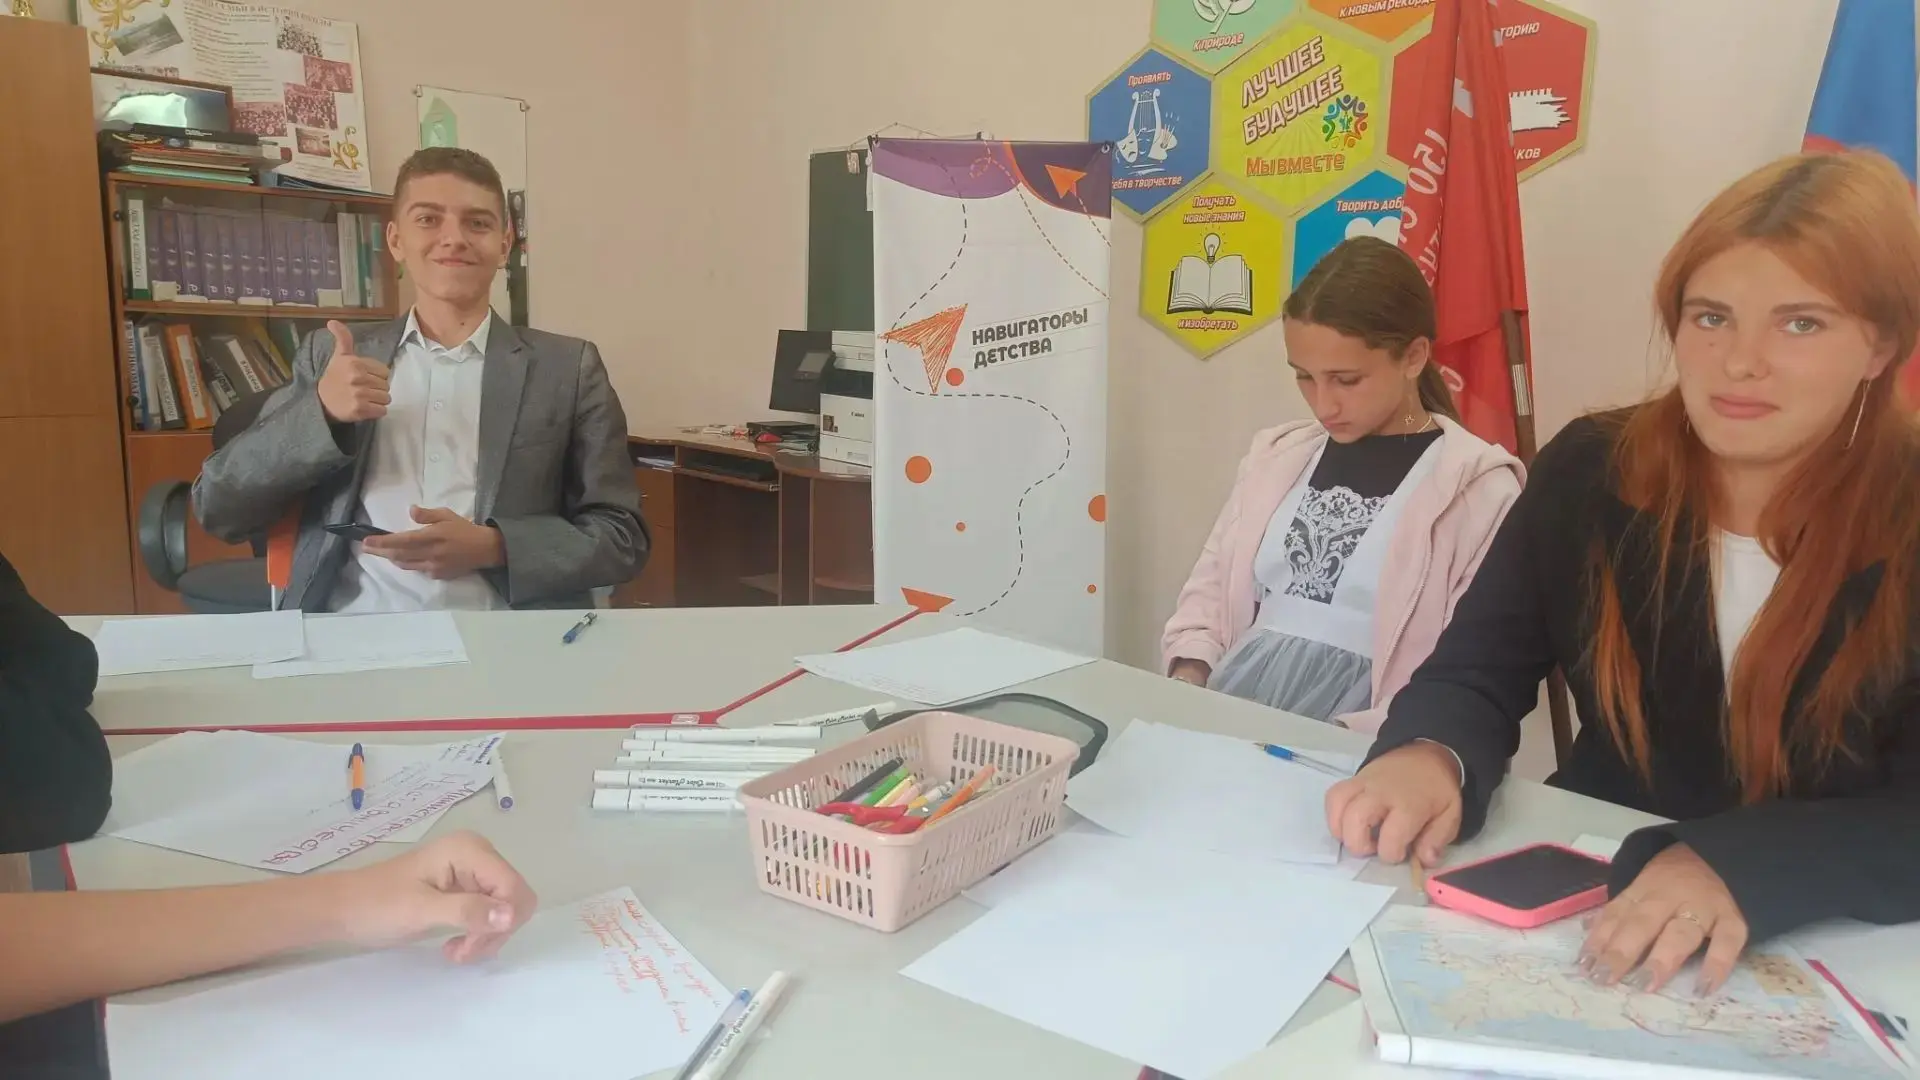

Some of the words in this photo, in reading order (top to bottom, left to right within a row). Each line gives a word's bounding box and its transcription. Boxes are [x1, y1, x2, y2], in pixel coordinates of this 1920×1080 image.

[1201, 33, 1245, 51] природе
[1127, 71, 1173, 87] Проявлять
[1242, 35, 1325, 109] ЛУЧШЕЕ
[1243, 64, 1344, 145] БУДУЩЕЕ
[1513, 147, 1542, 161] ков
[1246, 157, 1275, 176] Мы
[1277, 153, 1345, 175] вместе
[1134, 176, 1183, 190] творчестве
[1192, 195, 1237, 210] Получать
[1336, 199, 1380, 213] Творить
[1380, 196, 1404, 211] доб
[1183, 213, 1211, 224] новые
[1211, 211, 1246, 223] знания
[972, 308, 1088, 346] НАВИГАТОРЫ
[1184, 316, 1239, 331] изобретать
[974, 337, 1052, 369] ДЕТСТВА
